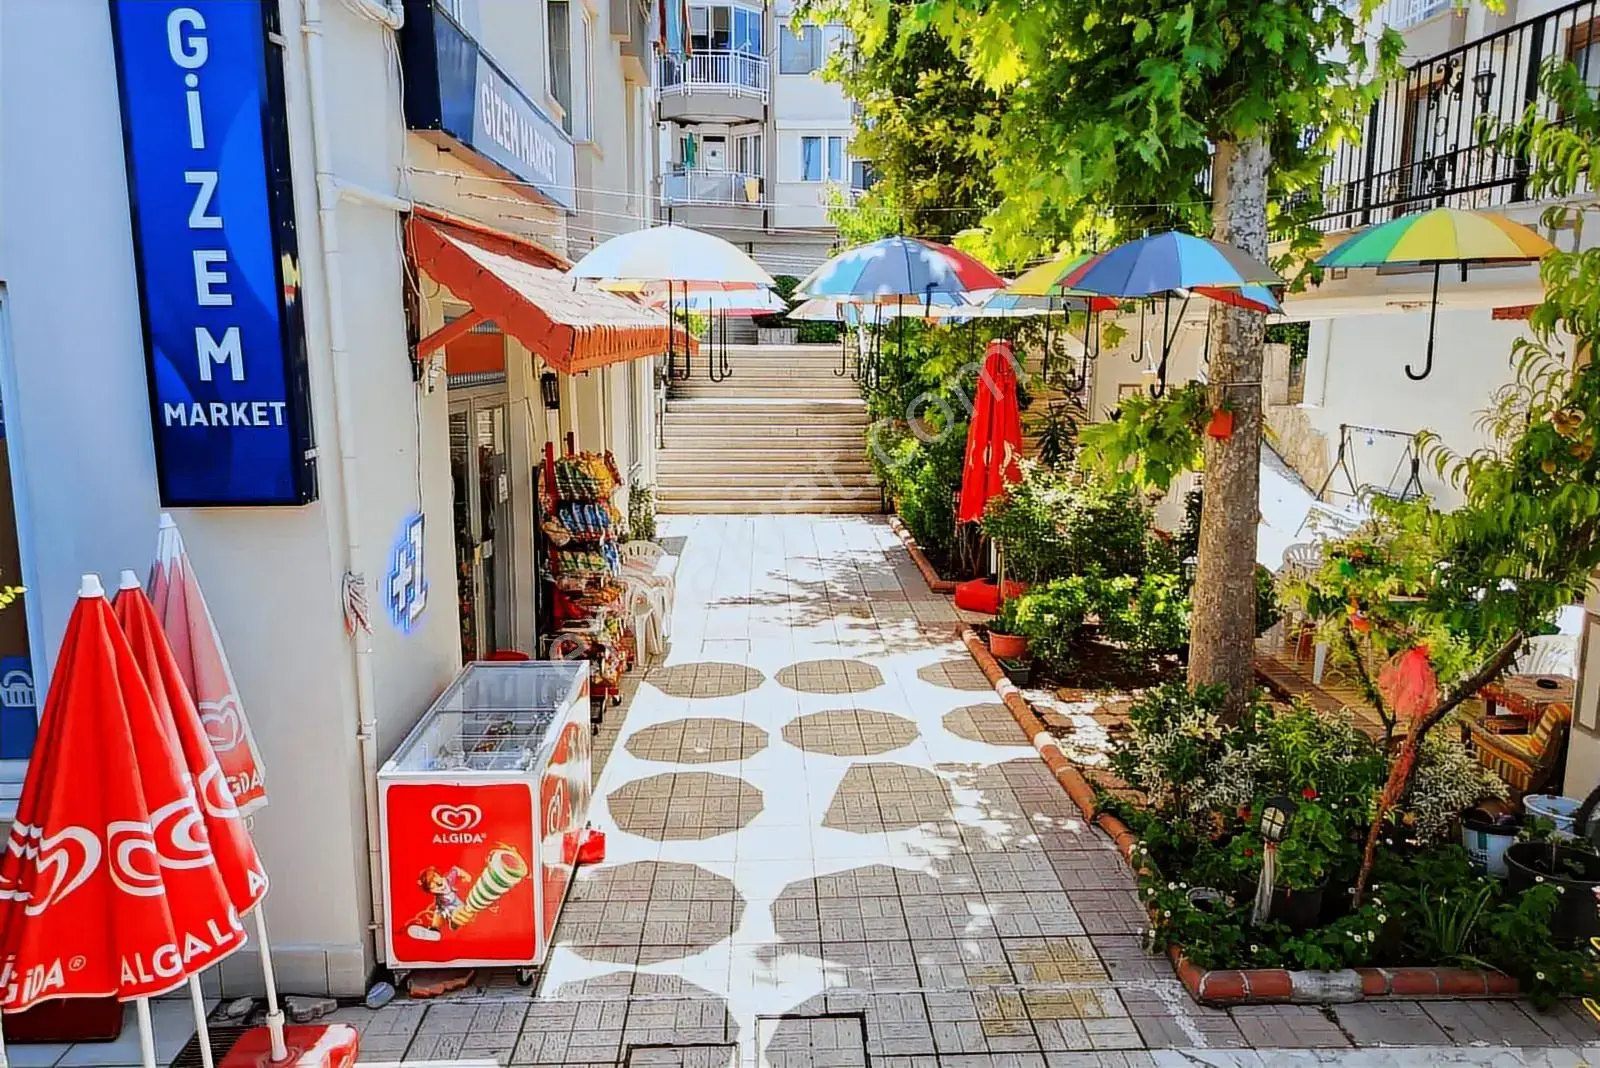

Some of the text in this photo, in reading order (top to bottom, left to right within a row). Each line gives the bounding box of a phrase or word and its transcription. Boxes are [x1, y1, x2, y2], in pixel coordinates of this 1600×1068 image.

[520, 116, 557, 185] MARKET
[167, 7, 244, 381] GİZEM
[163, 401, 286, 427] MARKET
